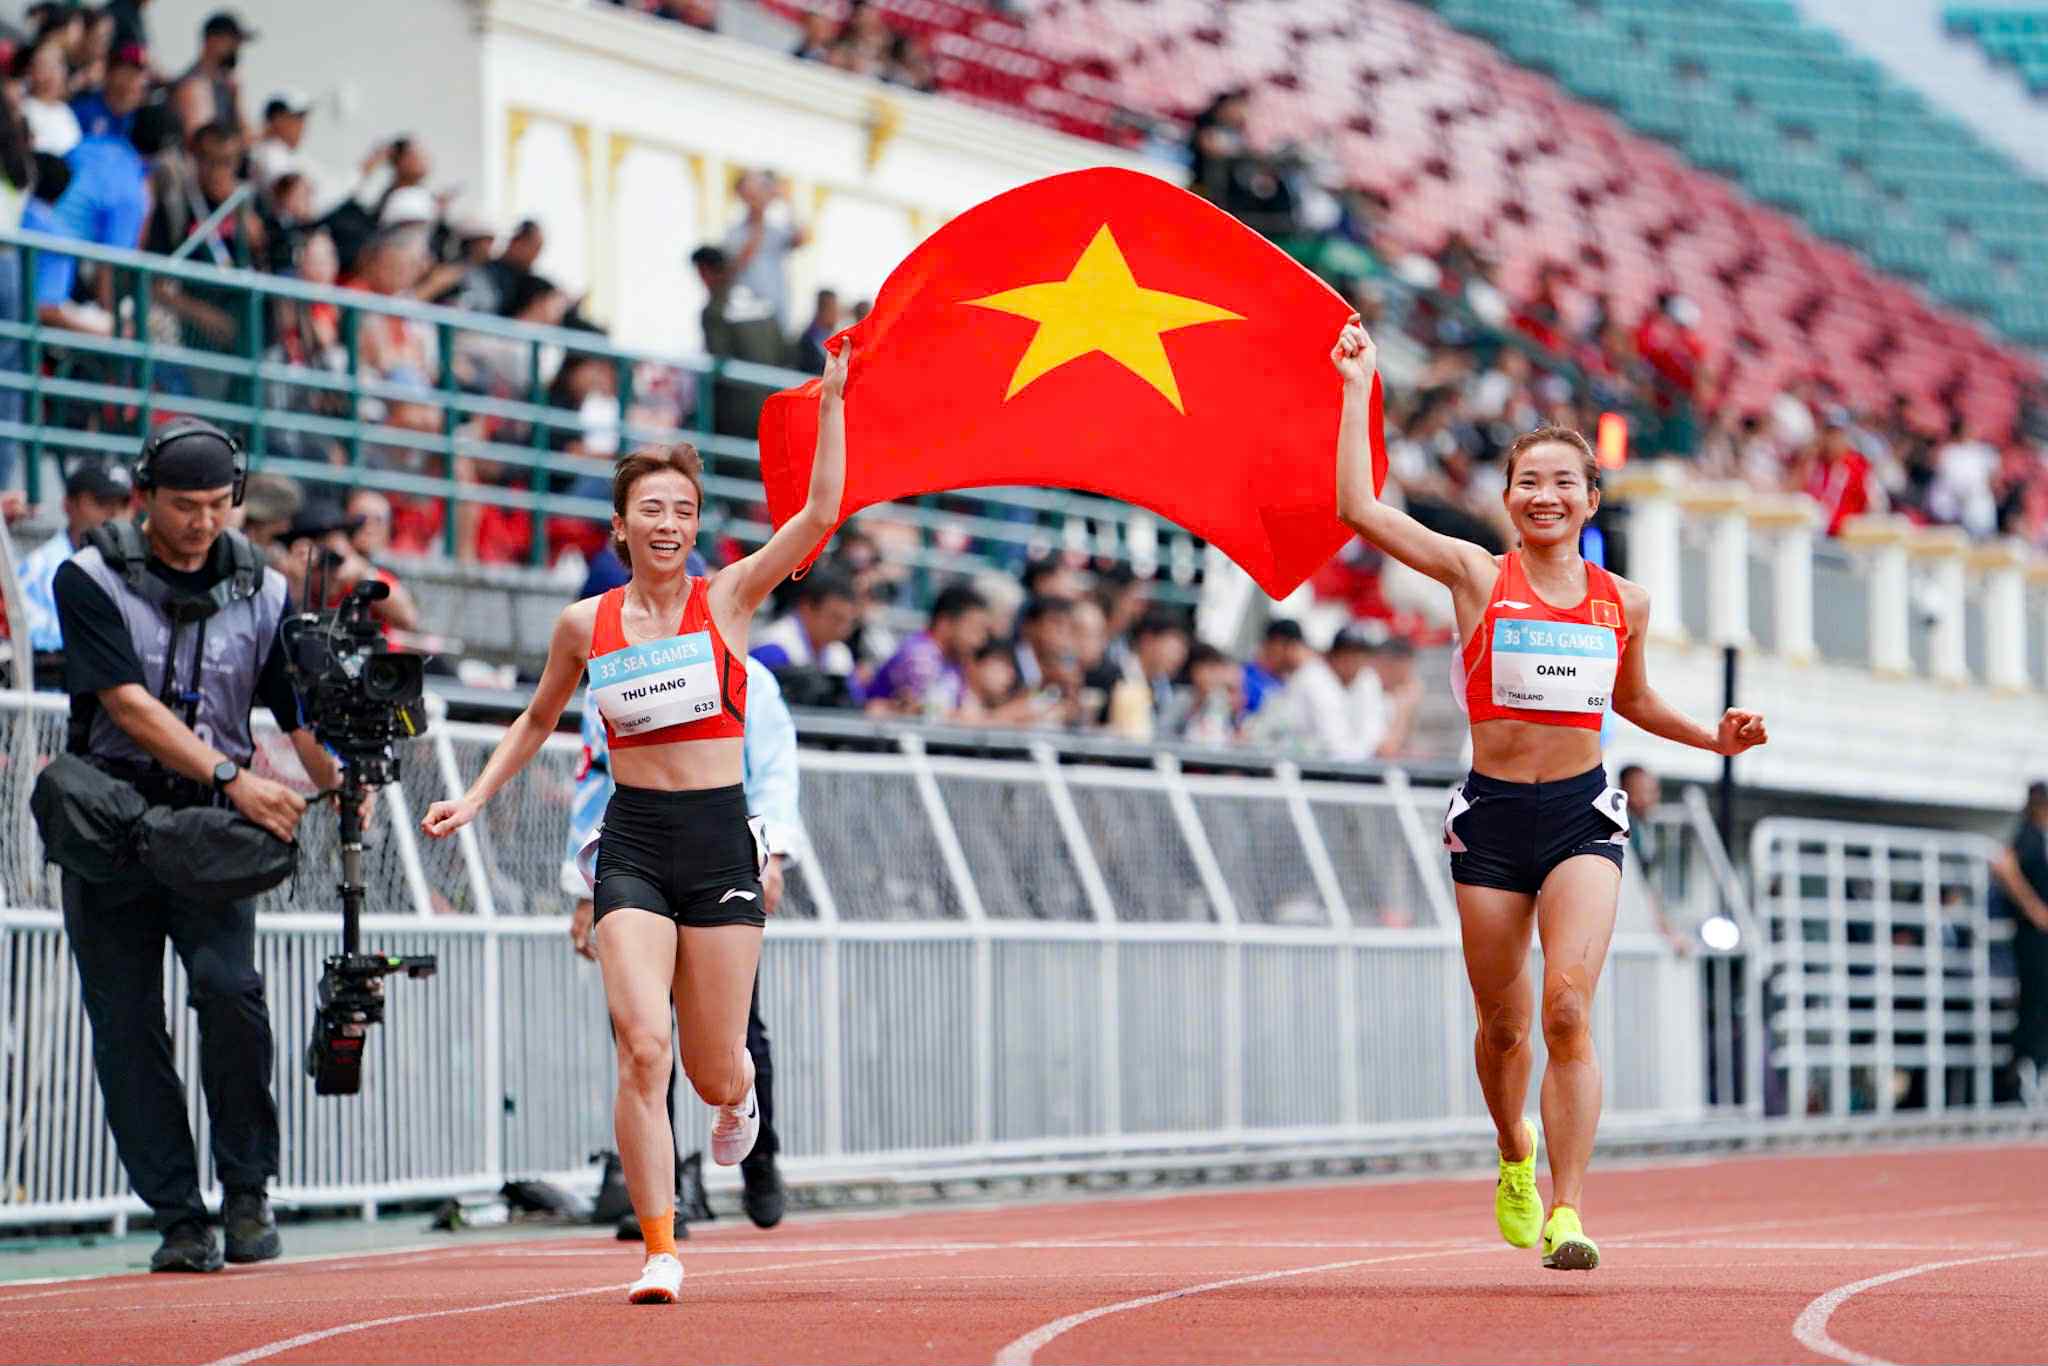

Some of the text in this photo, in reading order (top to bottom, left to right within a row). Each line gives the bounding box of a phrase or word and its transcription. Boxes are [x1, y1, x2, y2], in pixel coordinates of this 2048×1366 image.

[1529, 630, 1554, 648] SEA
[1559, 633, 1605, 650] GAMES
[623, 655, 648, 674] SEA
[650, 643, 699, 666] GAMES
[1536, 664, 1577, 677] OANH
[621, 678, 687, 702] THU HANG
[1507, 691, 1544, 701] THAILAND
[694, 701, 715, 713] 633
